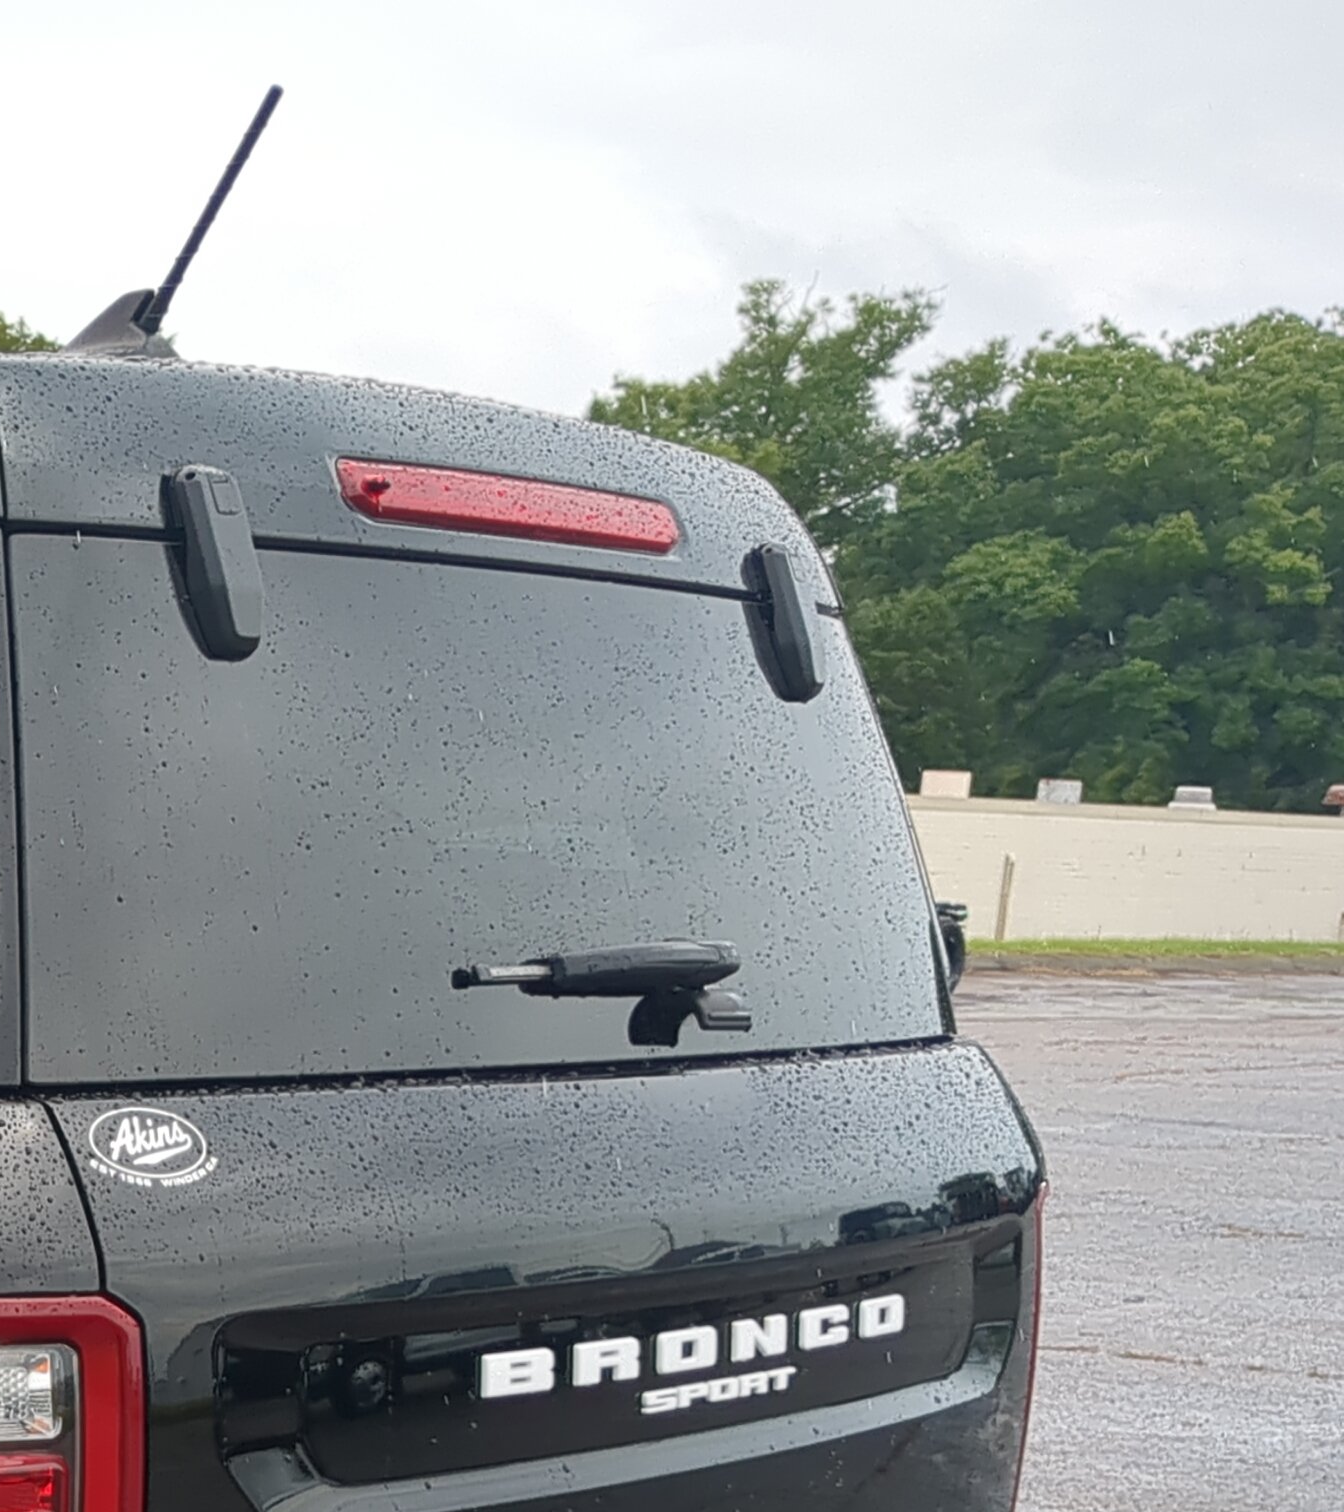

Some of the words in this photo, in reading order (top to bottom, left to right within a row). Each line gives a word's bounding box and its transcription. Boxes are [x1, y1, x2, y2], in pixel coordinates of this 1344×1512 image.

[110, 1116, 192, 1164] Akins
[160, 1168, 207, 1187] WINDER
[480, 1294, 904, 1398] BRONCO
[640, 1366, 797, 1414] SPORT
